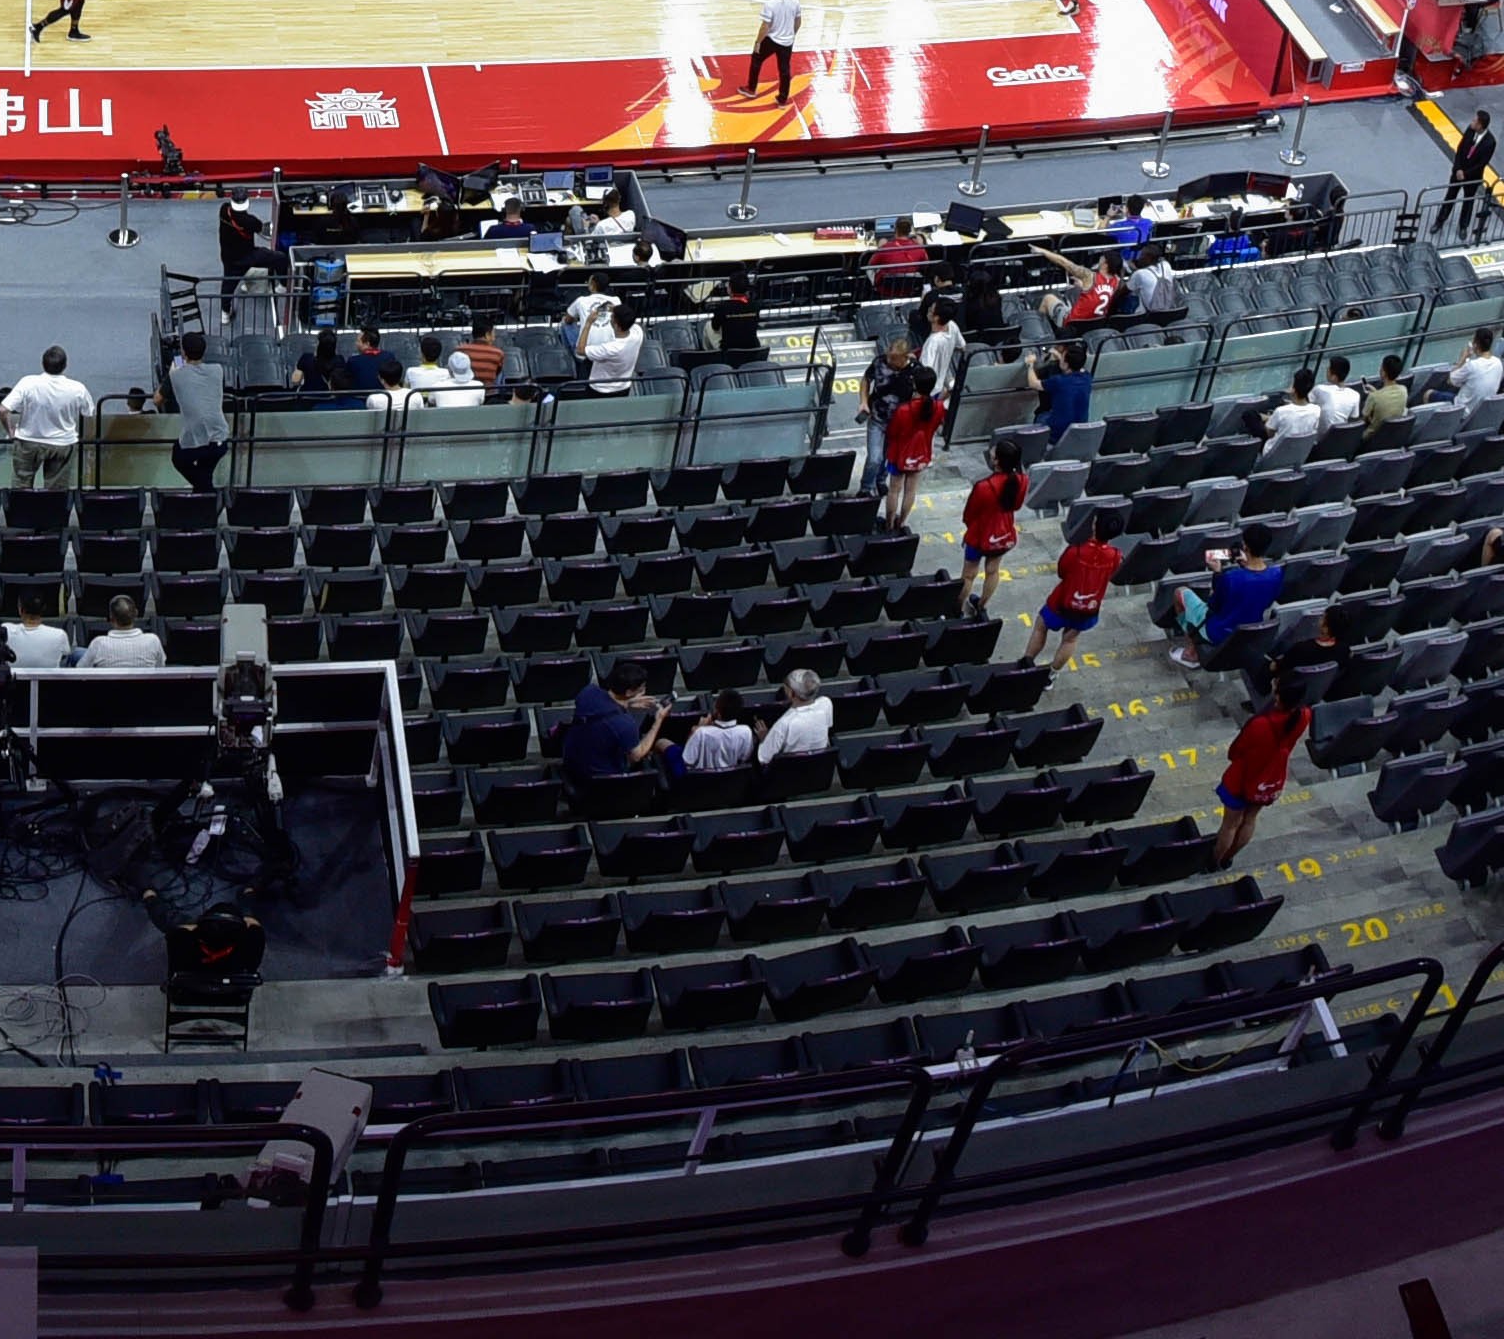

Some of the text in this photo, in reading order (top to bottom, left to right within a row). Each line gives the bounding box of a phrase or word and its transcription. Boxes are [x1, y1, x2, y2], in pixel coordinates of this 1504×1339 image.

[987, 64, 1079, 83] Gerflor
[1094, 294, 1109, 315] 2
[1108, 699, 1149, 720] 16
[1160, 748, 1199, 770] 17
[1277, 859, 1323, 883] 19
[1340, 918, 1390, 948] 20
